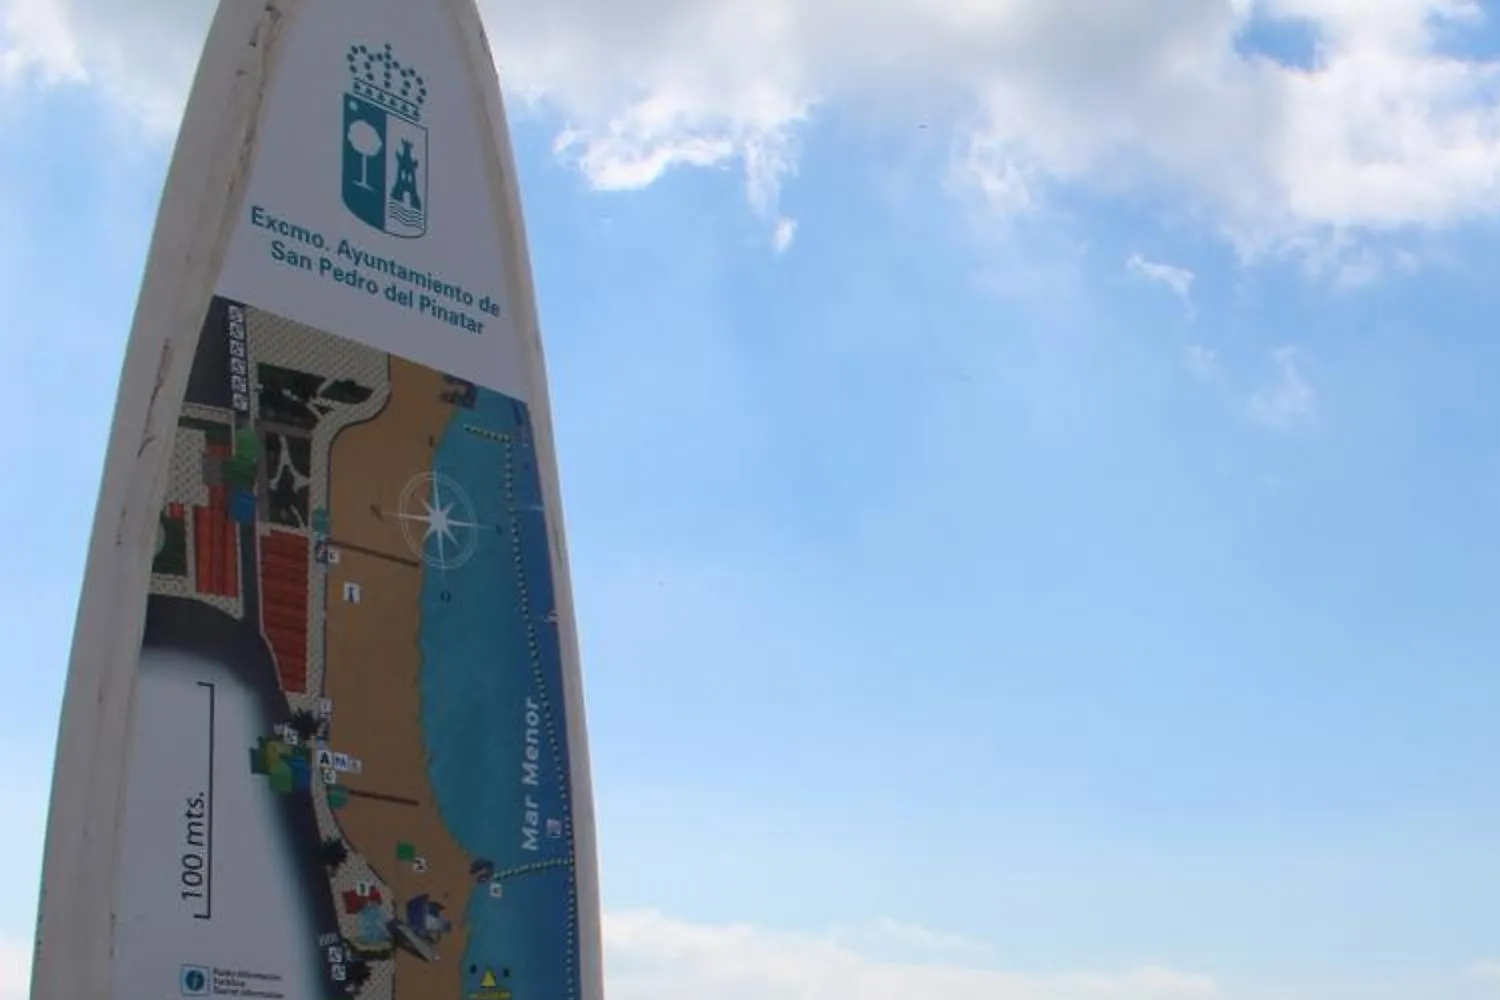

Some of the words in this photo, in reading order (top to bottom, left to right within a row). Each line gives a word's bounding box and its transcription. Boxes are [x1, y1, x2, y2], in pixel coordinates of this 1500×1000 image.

[251, 205, 331, 252] Excmo.
[337, 239, 474, 306] Ayuntamiento
[479, 296, 501, 317] de
[271, 240, 312, 271] San
[319, 256, 379, 295] Pedro
[384, 285, 414, 309] del
[419, 294, 484, 335] Pinatar
[521, 695, 540, 786] Menor
[185, 791, 205, 847] mts.
[521, 793, 540, 851] Mar
[181, 853, 204, 900] 100
